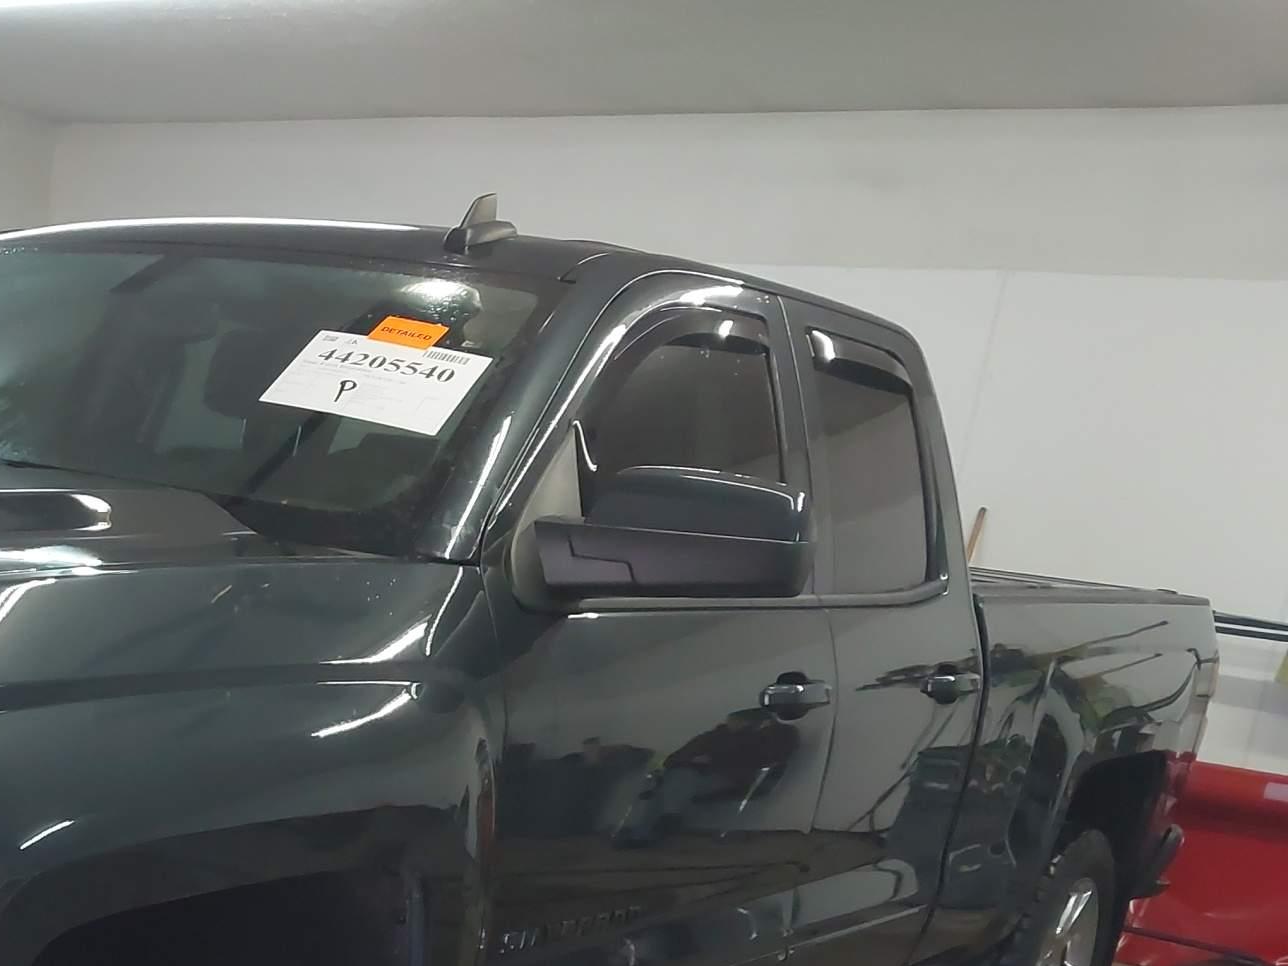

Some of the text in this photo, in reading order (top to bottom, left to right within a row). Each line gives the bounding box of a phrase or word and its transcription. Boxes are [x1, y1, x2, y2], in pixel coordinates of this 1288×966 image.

[380, 326, 432, 341] DETAILED
[318, 348, 455, 383] 44205540
[333, 379, 357, 402] P
